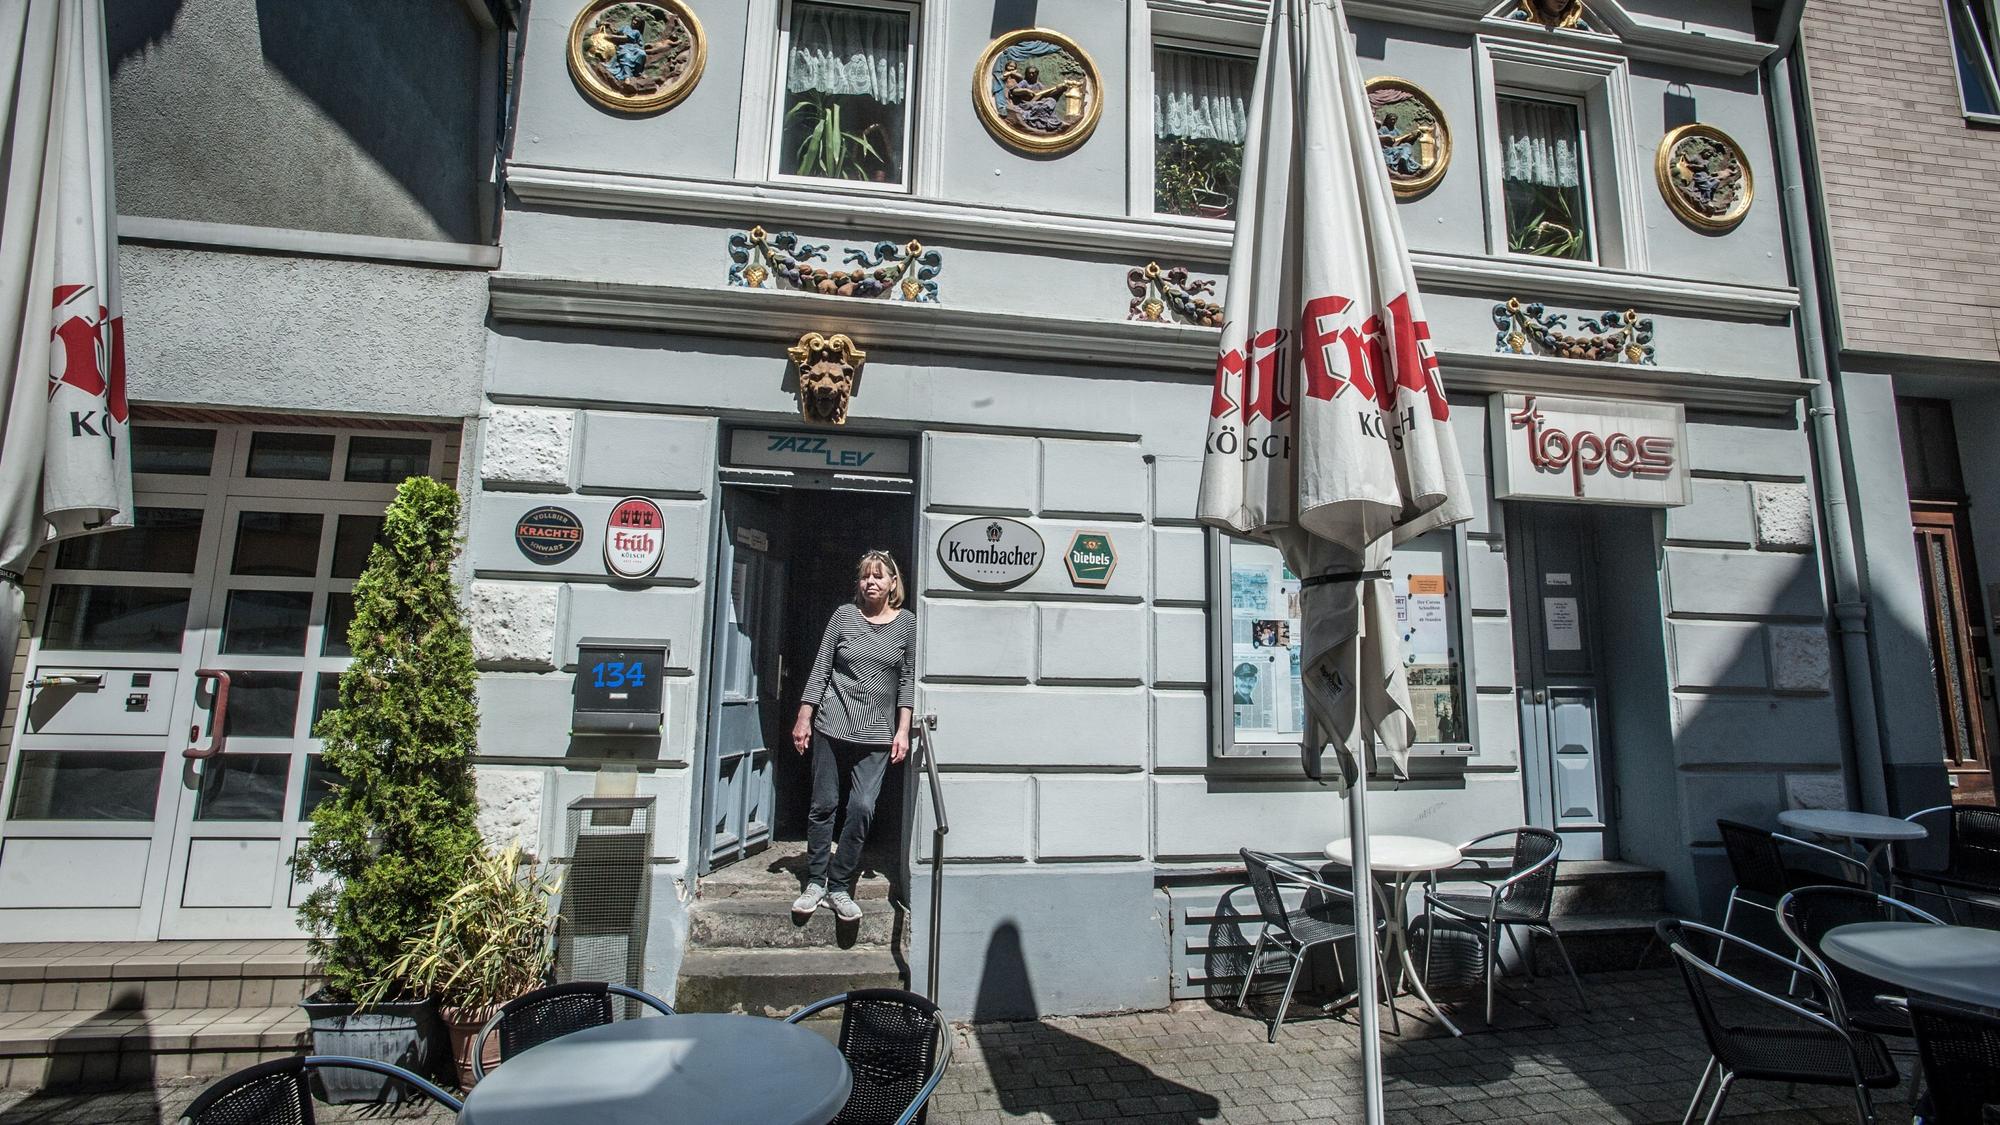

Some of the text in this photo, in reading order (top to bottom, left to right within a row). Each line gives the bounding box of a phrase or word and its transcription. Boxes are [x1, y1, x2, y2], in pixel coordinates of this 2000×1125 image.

[768, 435, 827, 453] JAZZ
[1511, 396, 1674, 497] topos
[826, 450, 875, 467] LEV
[533, 513, 569, 524] VOLLBIER
[519, 526, 580, 539] KRACHTS
[949, 541, 1037, 566] Krombacher
[1073, 551, 1110, 565] Diebels
[592, 662, 646, 688] 134
